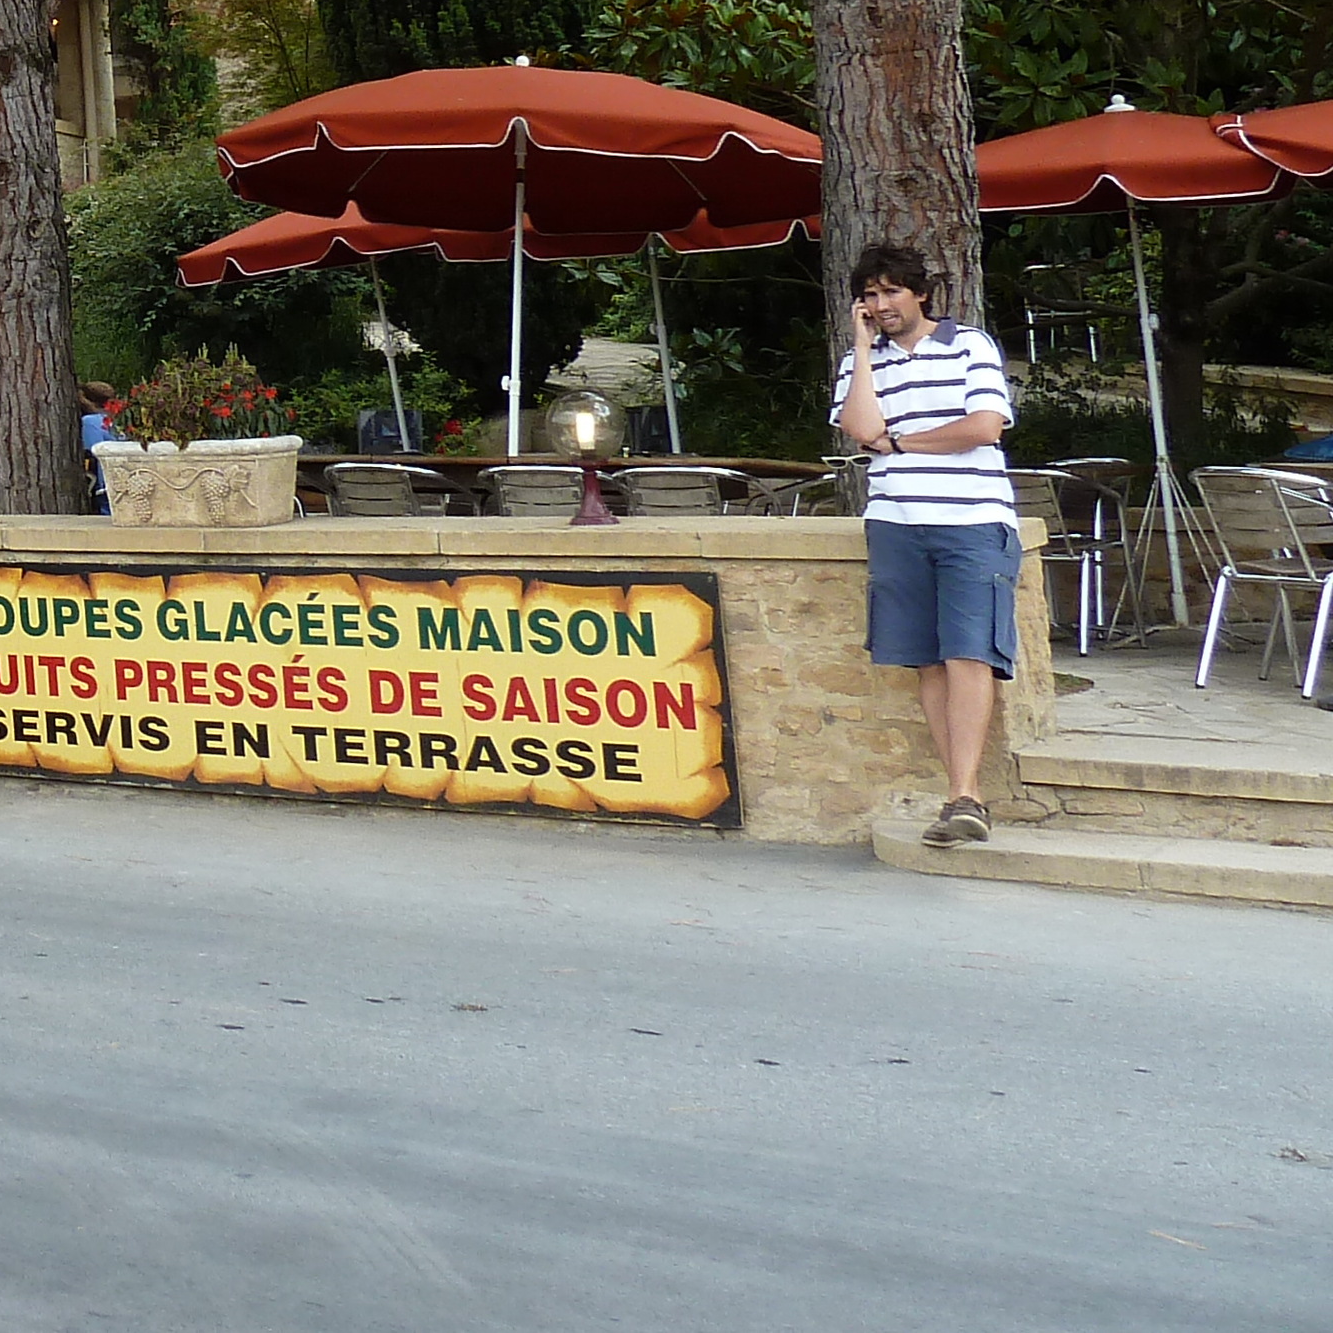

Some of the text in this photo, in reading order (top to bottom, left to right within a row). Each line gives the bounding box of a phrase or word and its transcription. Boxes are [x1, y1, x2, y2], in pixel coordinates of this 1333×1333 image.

[155, 591, 401, 650] GLACÉES
[416, 606, 658, 657] MAISON
[113, 653, 349, 713] PRESSÉS
[368, 669, 443, 718] DE
[461, 673, 698, 731] SAISON
[194, 720, 271, 759] EN
[291, 725, 643, 783] TERRASSE
